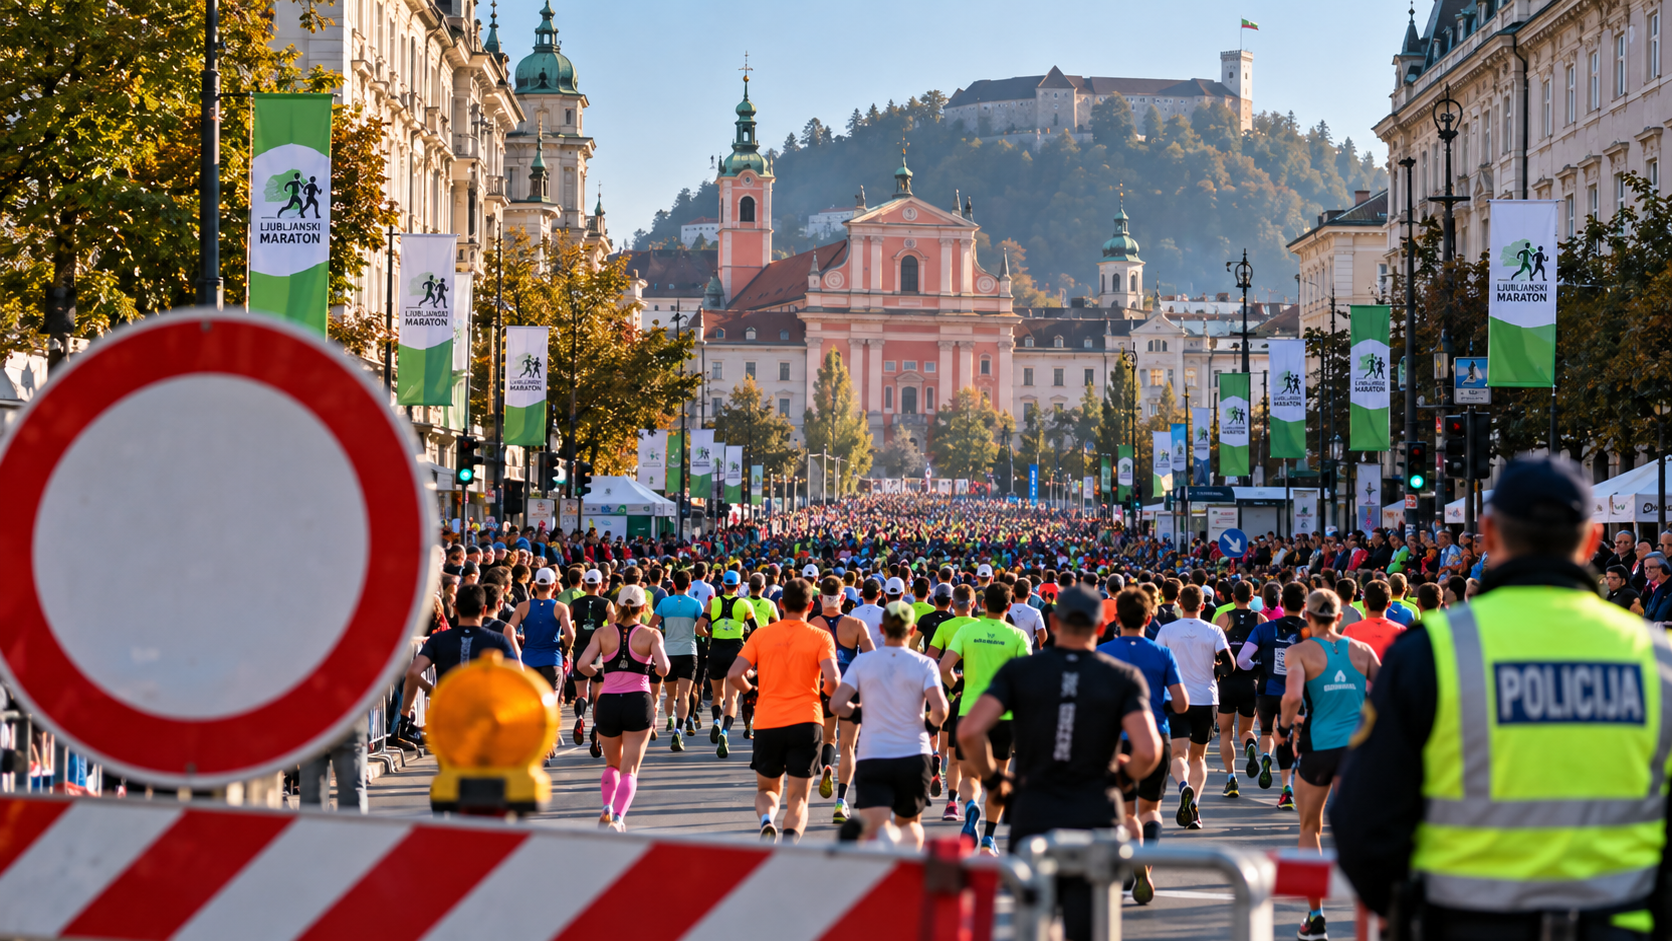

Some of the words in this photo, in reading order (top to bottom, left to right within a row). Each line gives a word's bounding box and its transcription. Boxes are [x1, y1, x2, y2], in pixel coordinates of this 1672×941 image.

[260, 222, 321, 231] LJUBLJANSKI
[260, 232, 321, 244] MARATON
[1497, 283, 1548, 292] LJUBLJANSKI
[1497, 292, 1547, 302] MARATON
[405, 318, 447, 326] MARATON
[1499, 664, 1643, 720] POLICIJA
